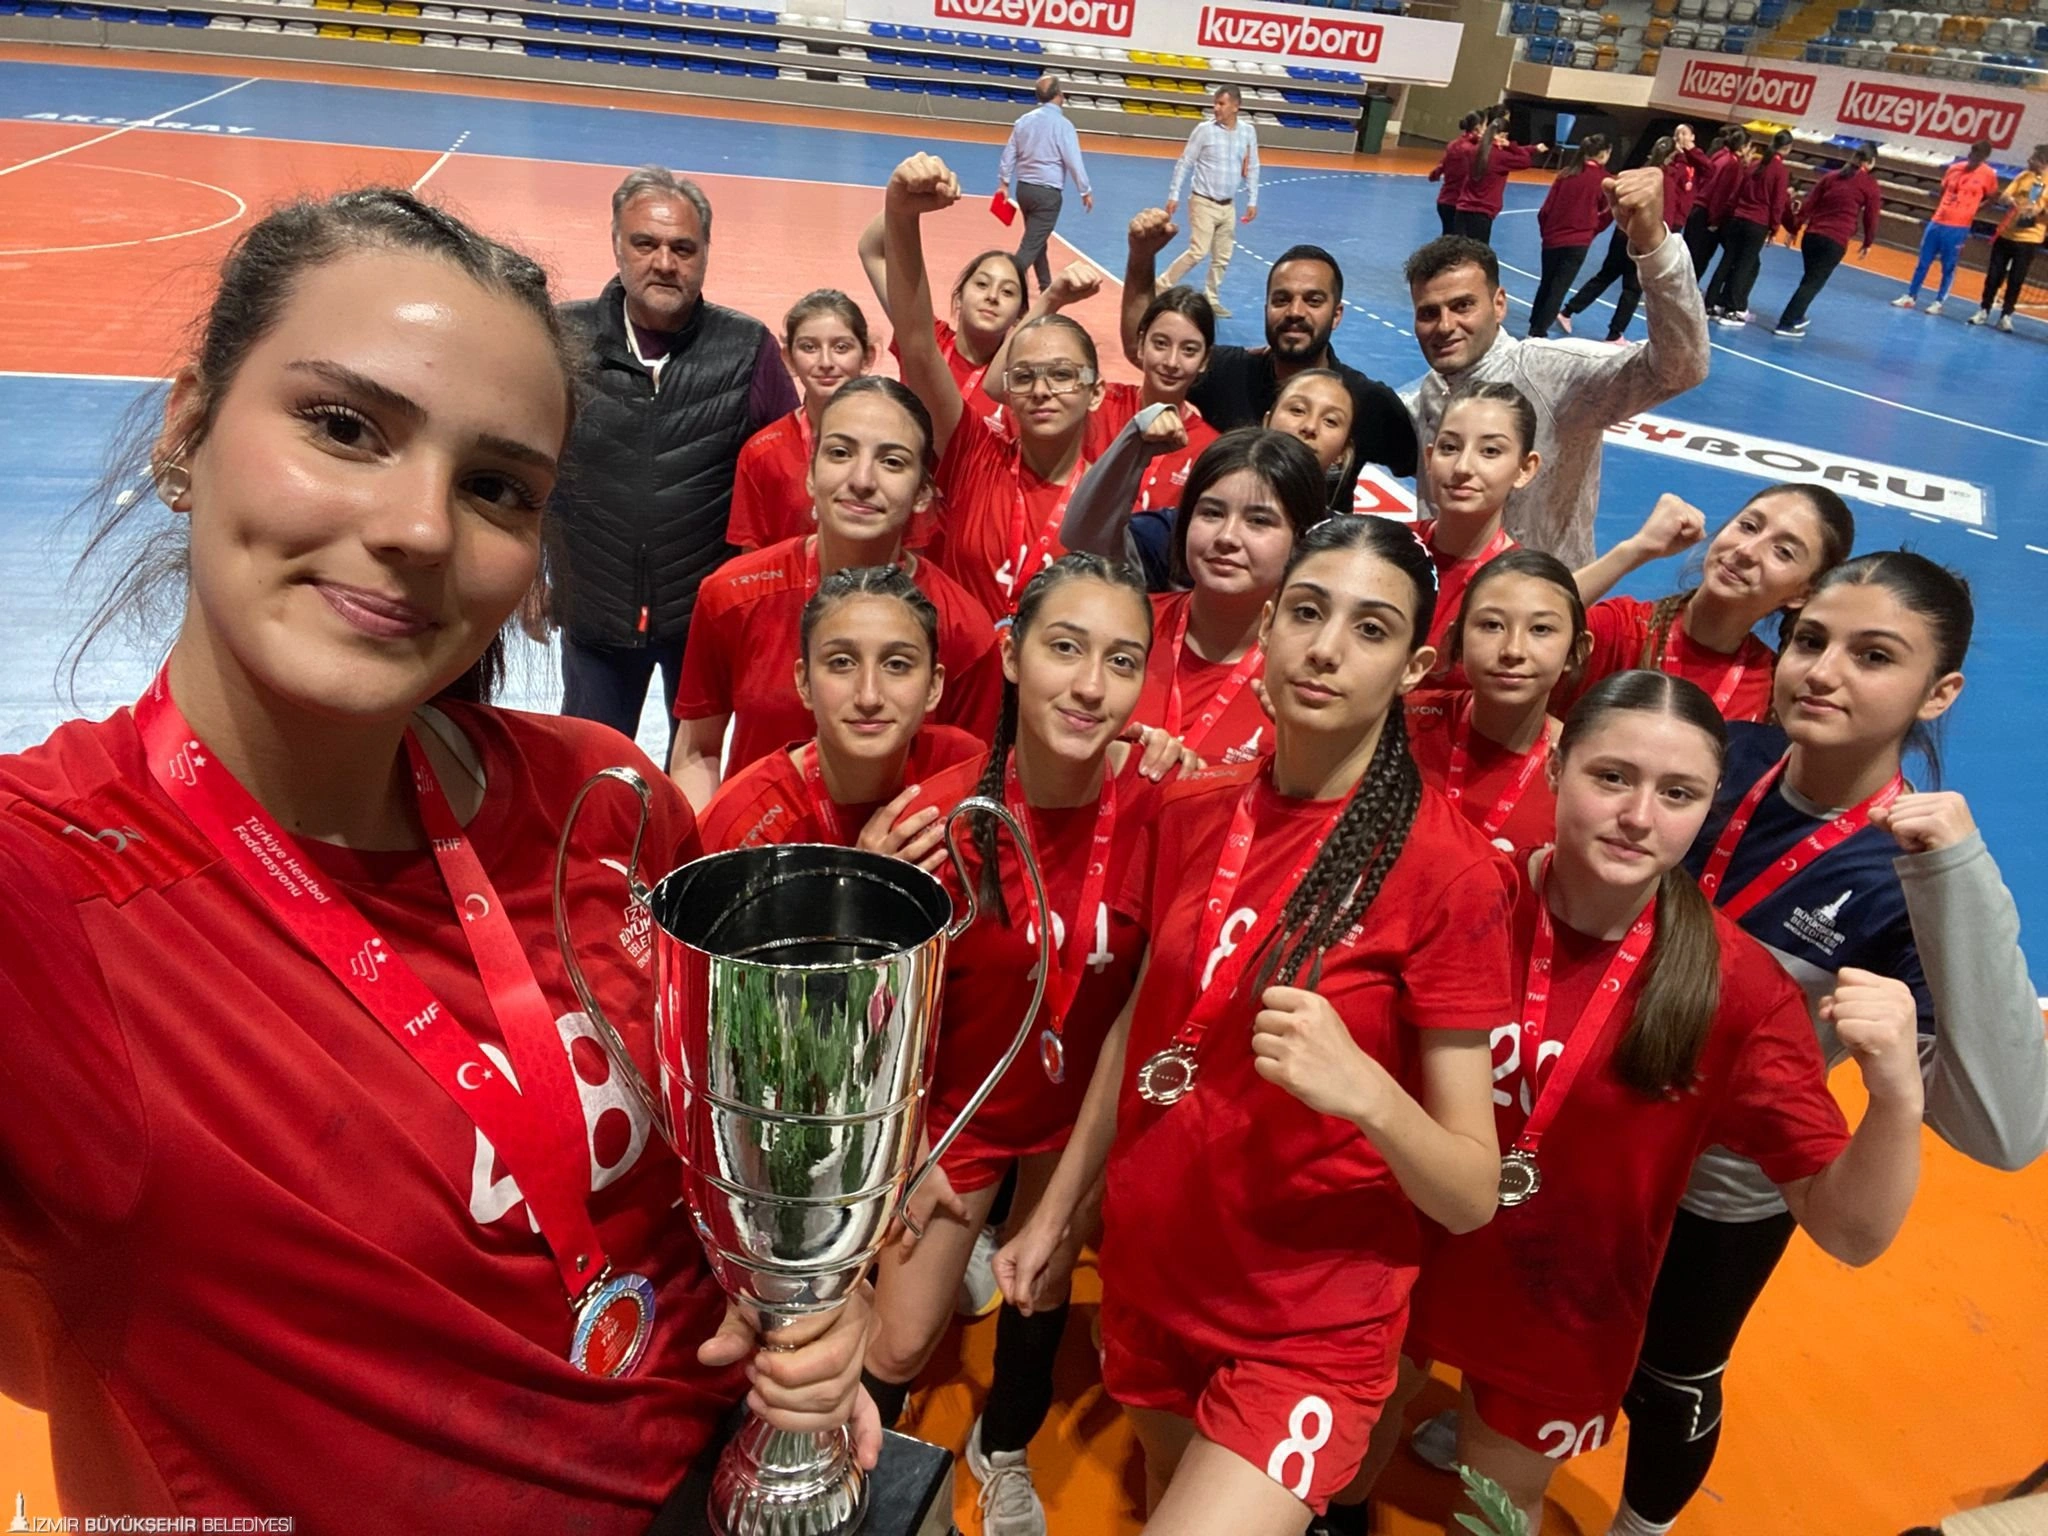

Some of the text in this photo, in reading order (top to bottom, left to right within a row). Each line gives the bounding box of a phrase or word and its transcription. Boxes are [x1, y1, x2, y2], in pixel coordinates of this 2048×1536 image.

[1204, 9, 1378, 57] kuzeyboru
[1682, 60, 1811, 109] kuzeyboru
[22, 112, 256, 134] AKSARAY
[1842, 81, 2016, 142] kuzeyboru
[232, 825, 304, 898] Federasyonu
[245, 815, 332, 904] Türkiye Hentbol
[432, 837, 462, 853] THF
[403, 1001, 441, 1037] THF
[1267, 1394, 1333, 1500] 8
[1537, 1414, 1606, 1460] 20
